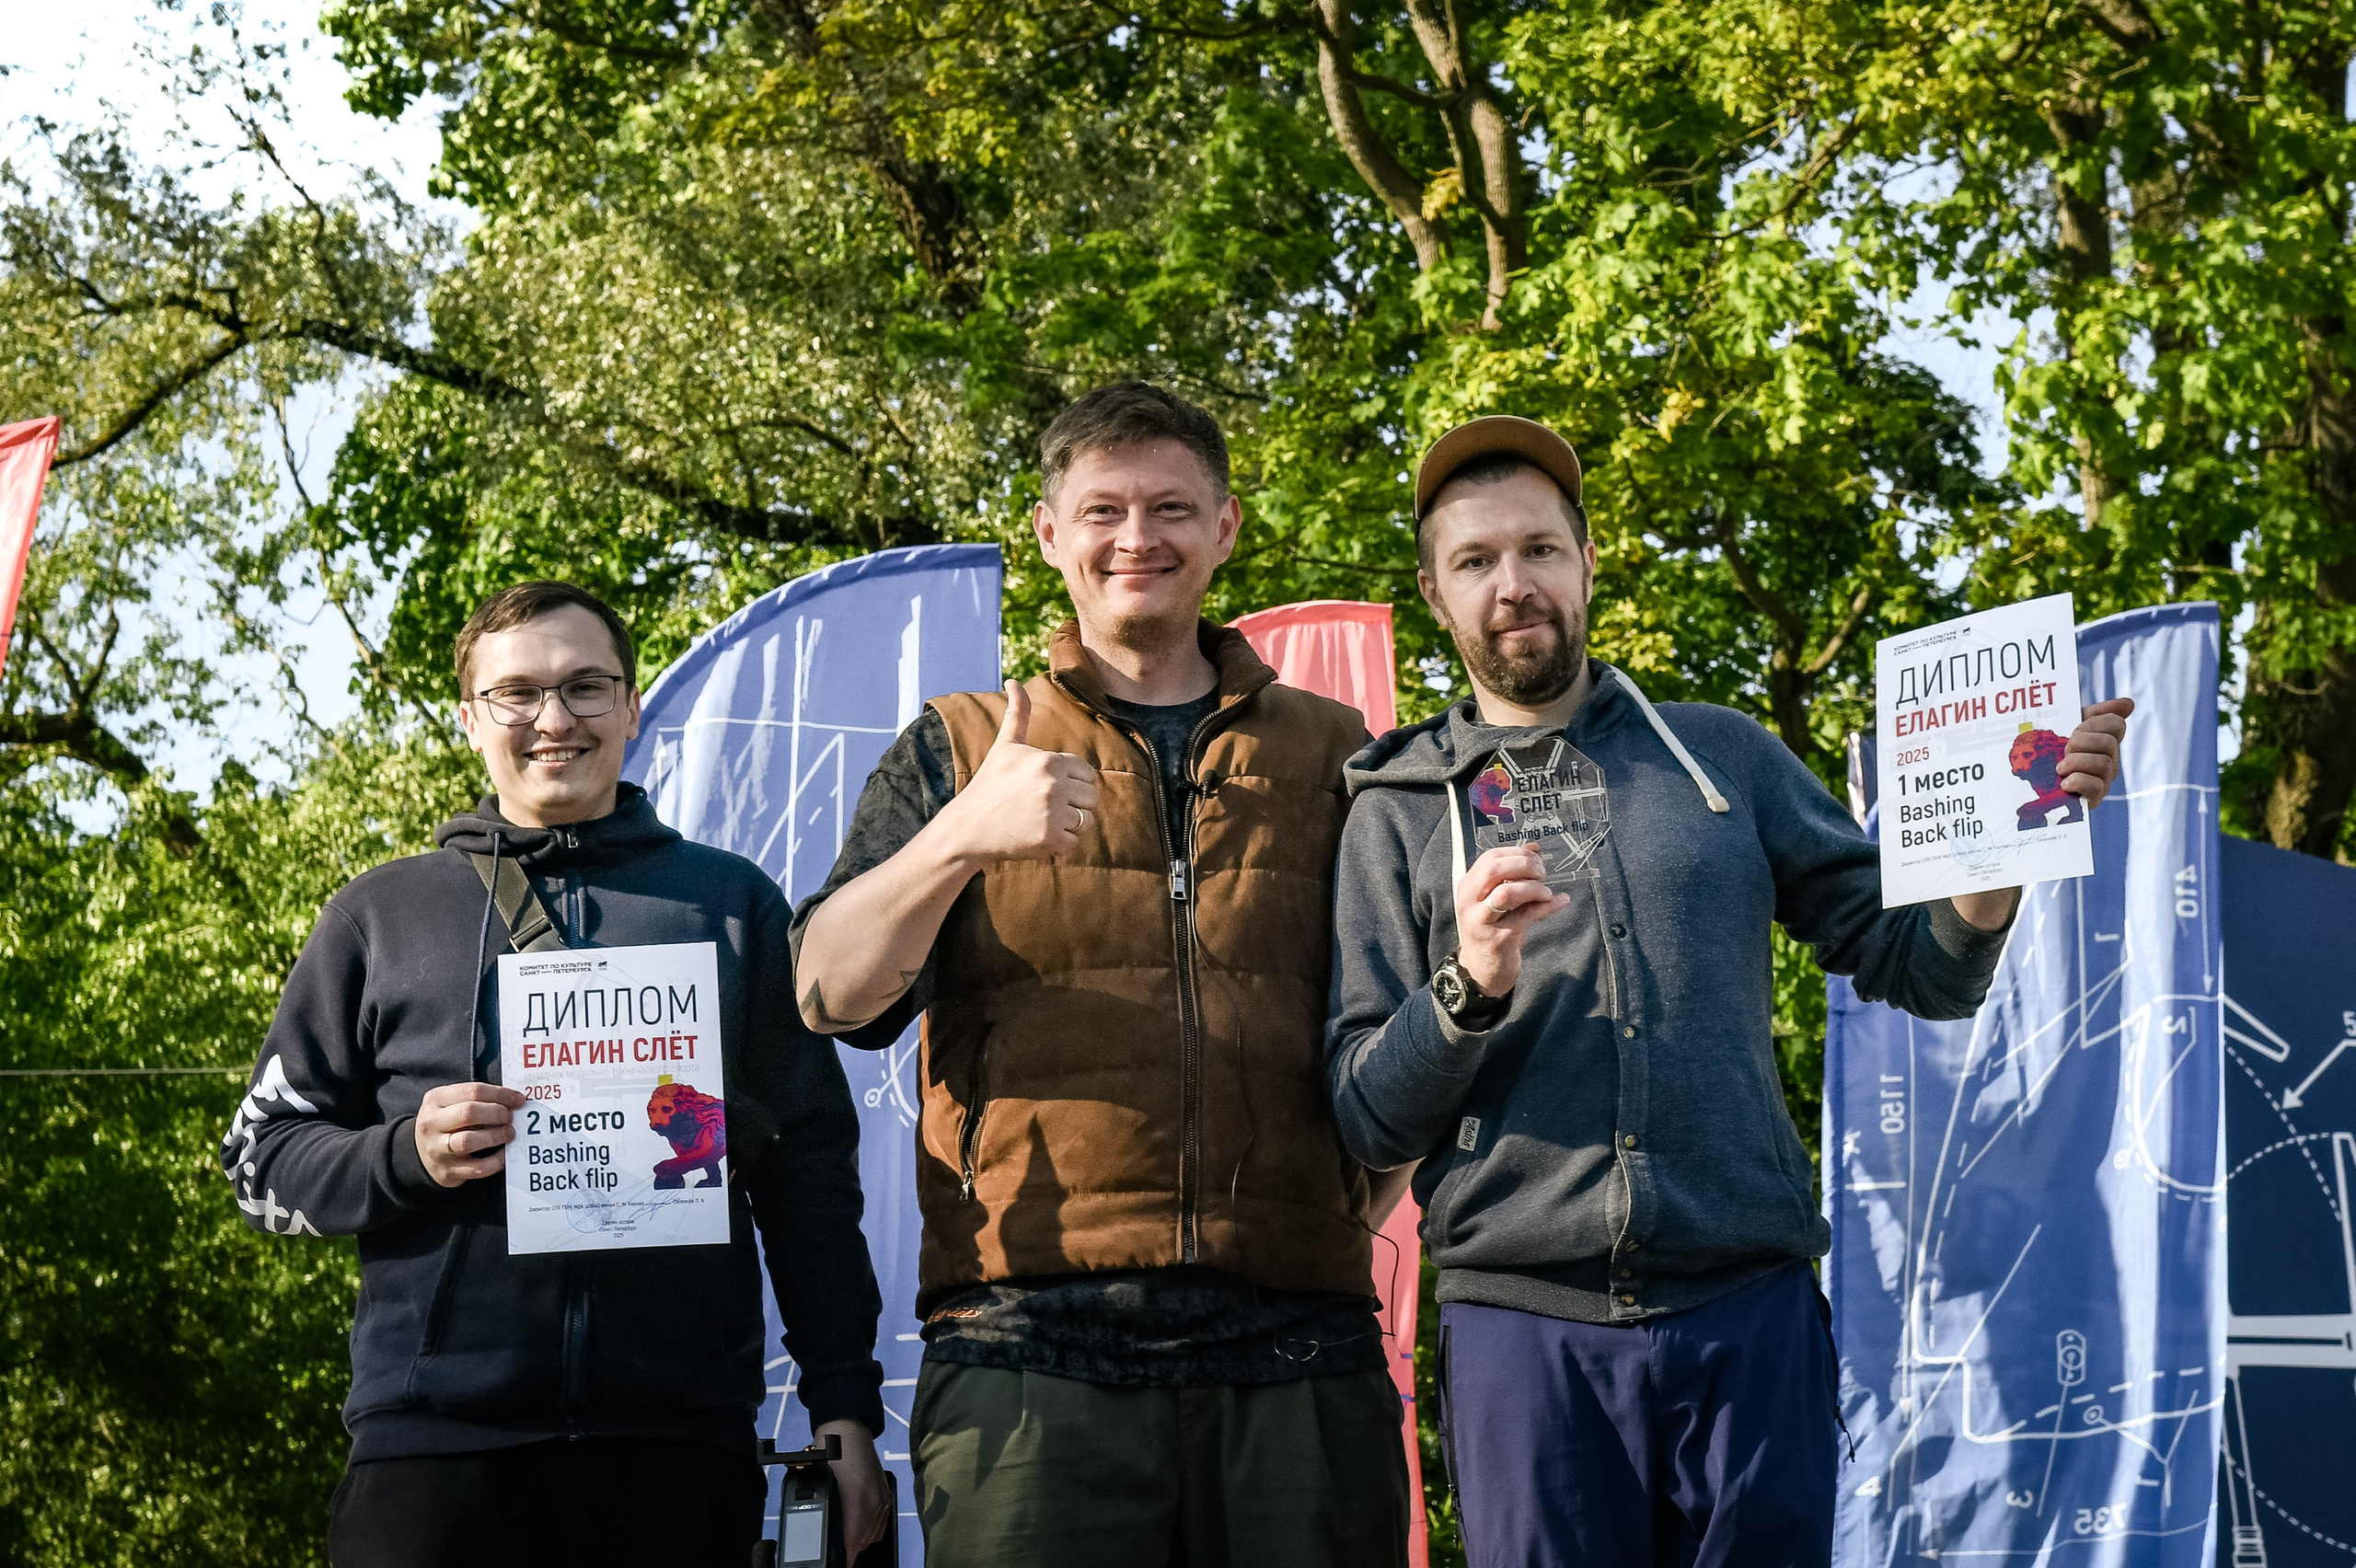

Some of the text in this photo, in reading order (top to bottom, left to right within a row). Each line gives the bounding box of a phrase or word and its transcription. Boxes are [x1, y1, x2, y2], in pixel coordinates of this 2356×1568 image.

[1896, 635, 2056, 710] ДИПЛОМ
[1895, 696, 1986, 737] ЕЛАГИН
[1995, 680, 2057, 714] СЛЁТ
[1897, 747, 1930, 767] 2025
[1519, 767, 1582, 792] ЕЛАГИН
[1898, 763, 1984, 795] 1 место
[1519, 790, 1562, 813] СЛЁТ
[1900, 796, 1976, 824] Bashing
[1497, 821, 1589, 843] Bashing Back flip
[1901, 816, 1983, 847] Back flip
[523, 984, 698, 1037] ДИПЛОМ
[523, 1030, 699, 1068] ЕЛАГИН СЛЁТ
[525, 1084, 561, 1101] 2025
[526, 1110, 625, 1135] 2 место
[528, 1141, 610, 1166] Bashing
[529, 1168, 618, 1193] Back flip
